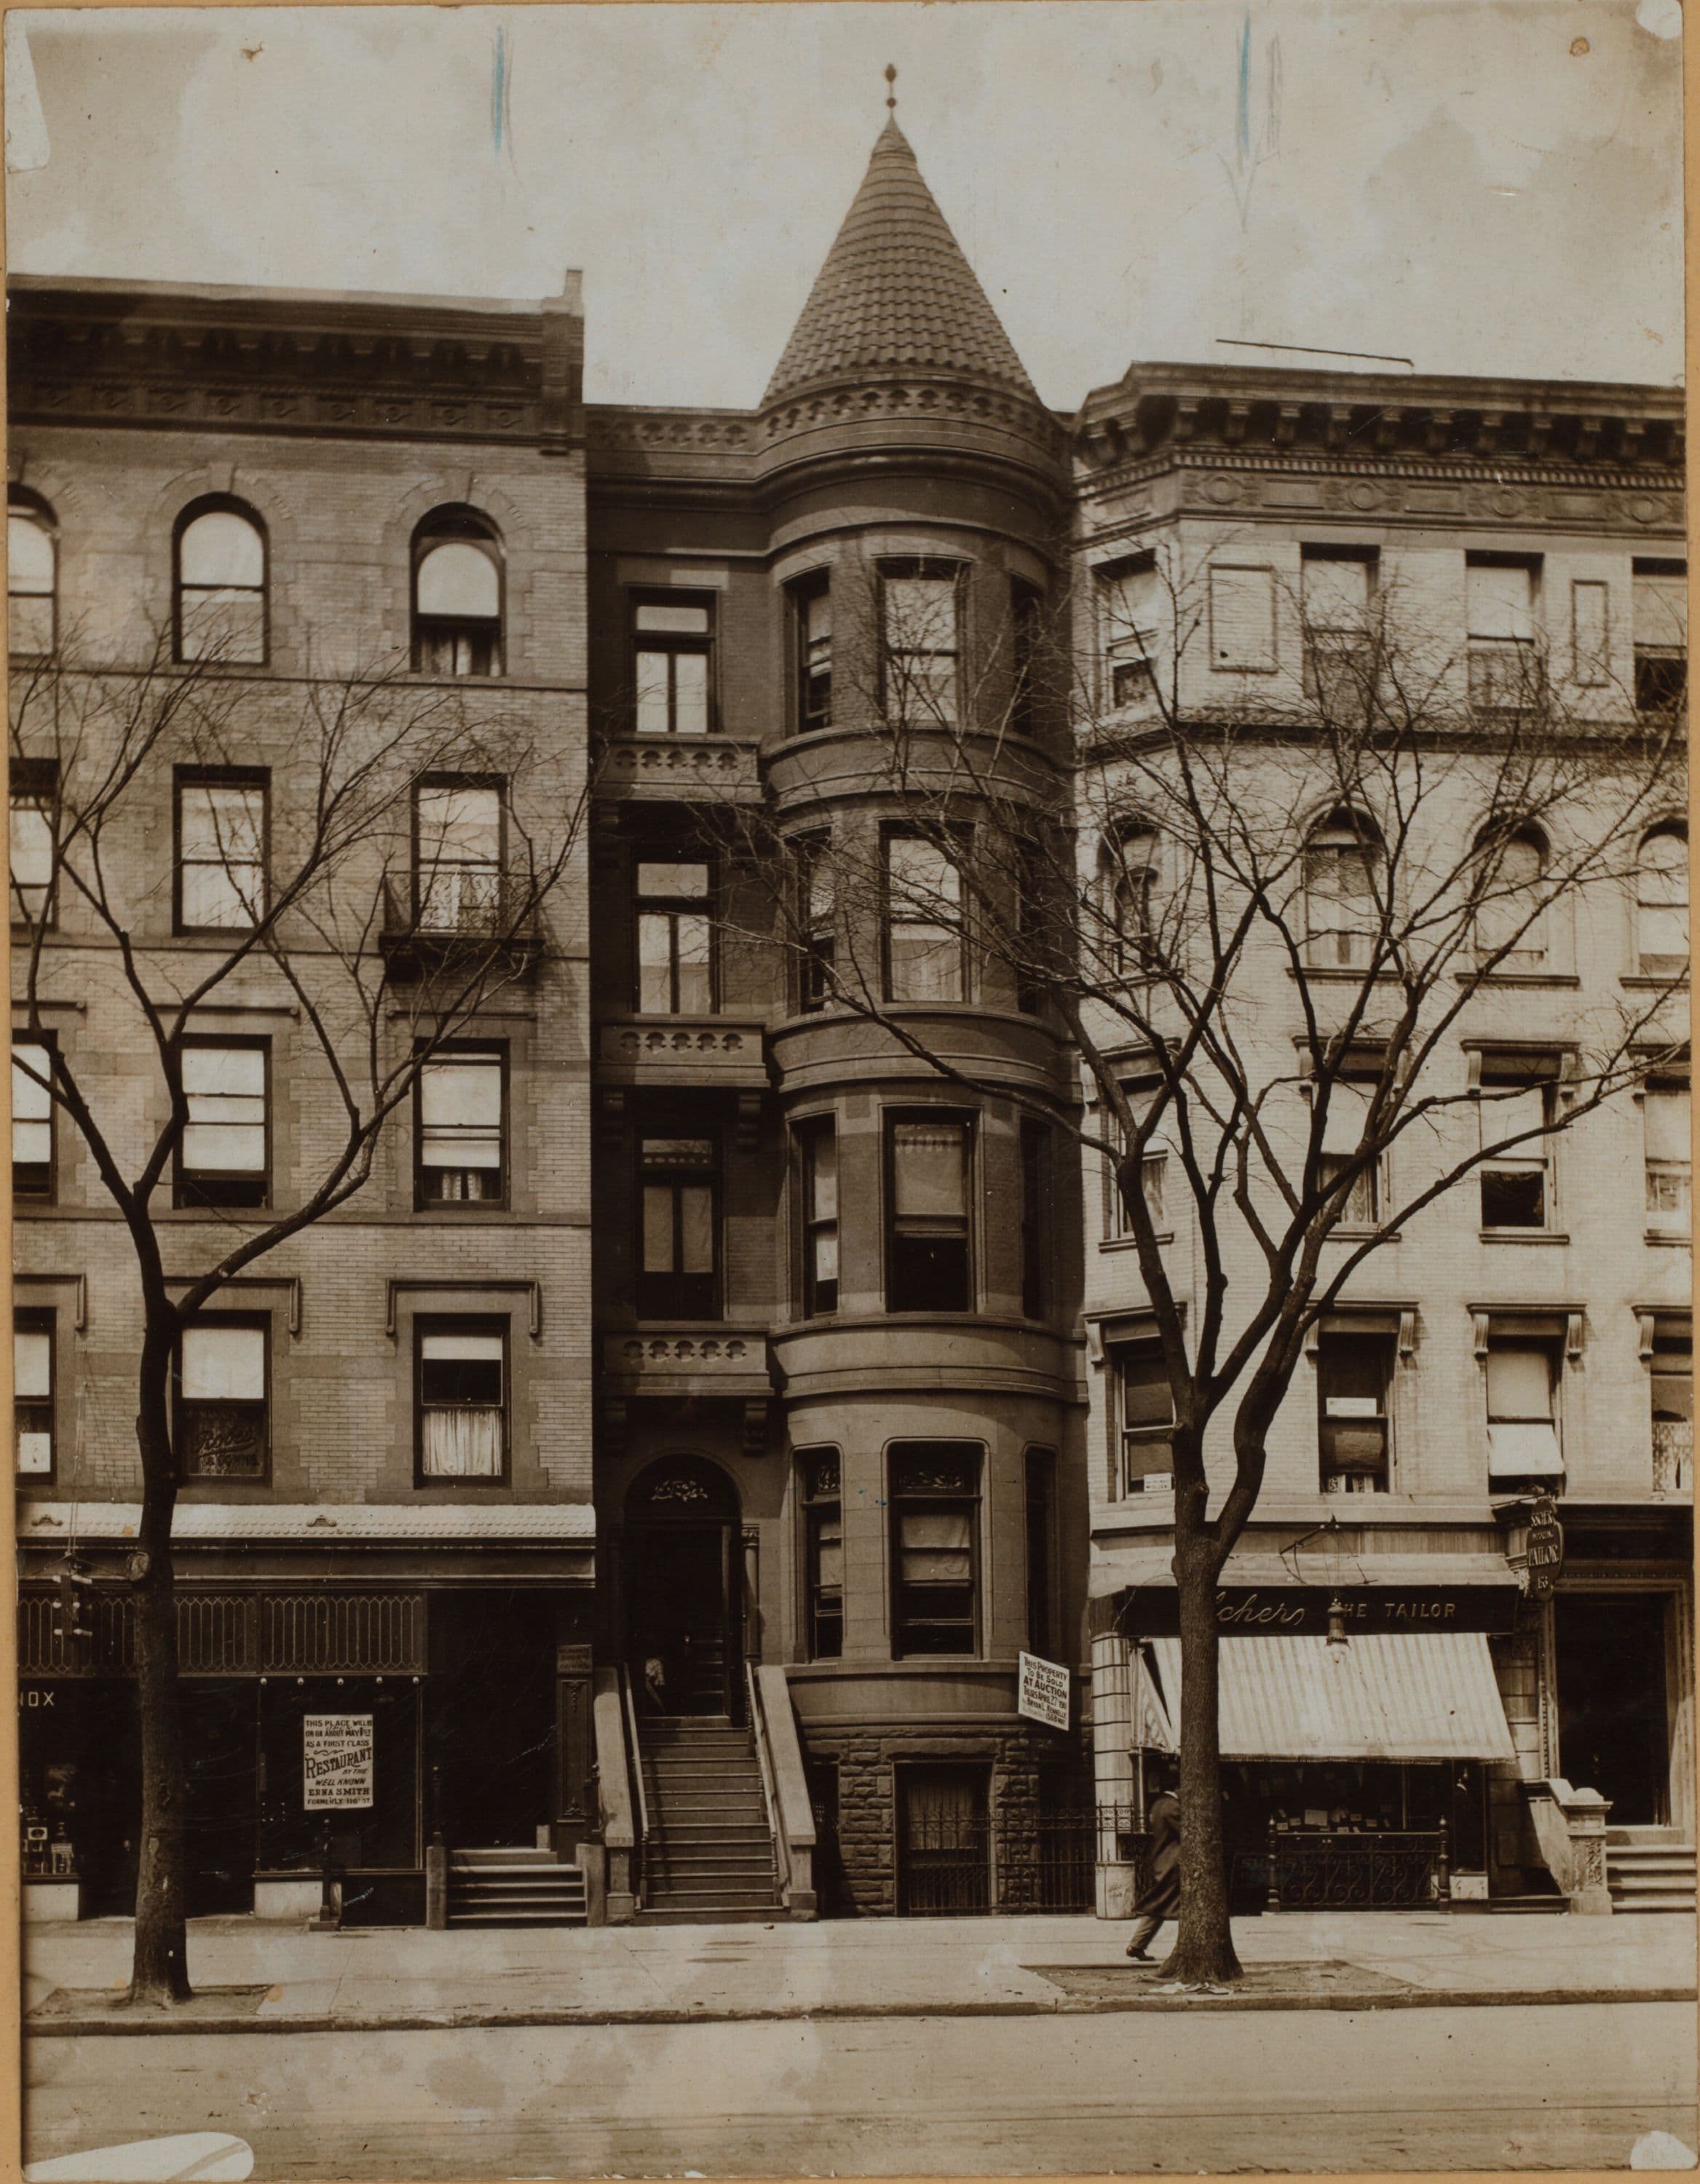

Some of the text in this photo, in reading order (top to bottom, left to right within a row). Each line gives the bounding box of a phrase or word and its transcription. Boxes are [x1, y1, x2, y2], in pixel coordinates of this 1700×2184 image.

[1216, 1591, 1455, 1626] chers HE TAILOR
[1024, 1656, 1067, 1681] THIS PROPERTY
[1027, 1667, 1063, 1688] TO BE SOLD
[1024, 1676, 1067, 1699] AT AUCTION
[20, 1691, 55, 1707] OX
[304, 1747, 372, 1779] RESTAURANT
[336, 1777, 366, 1786] KNOWN
[336, 1787, 370, 1795] SMITH
